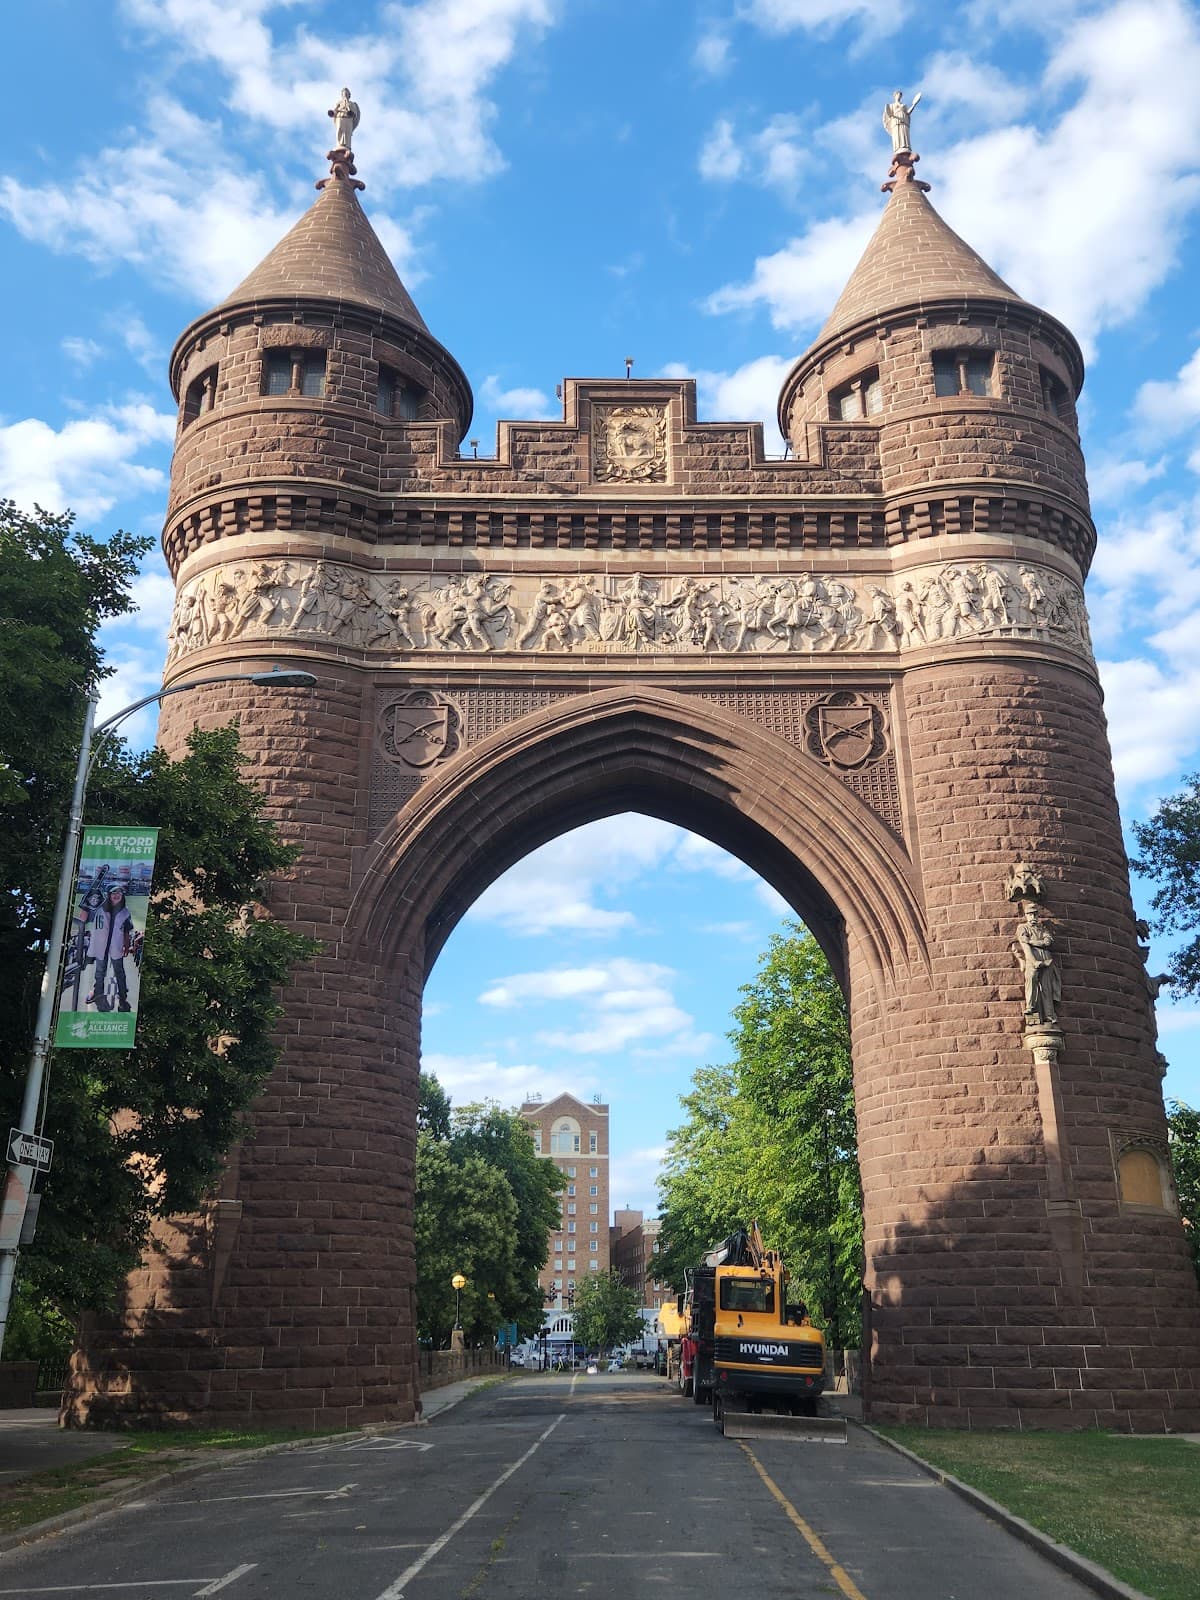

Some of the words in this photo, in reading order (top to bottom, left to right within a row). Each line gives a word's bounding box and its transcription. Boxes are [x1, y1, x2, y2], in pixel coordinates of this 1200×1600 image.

[86, 836, 154, 847] HARTFORD
[123, 846, 141, 854] HAS
[143, 846, 153, 854] IT
[87, 1024, 129, 1032] ALLIANCE
[20, 1142, 34, 1157] ONE
[740, 1343, 789, 1356] HYUNDAI
